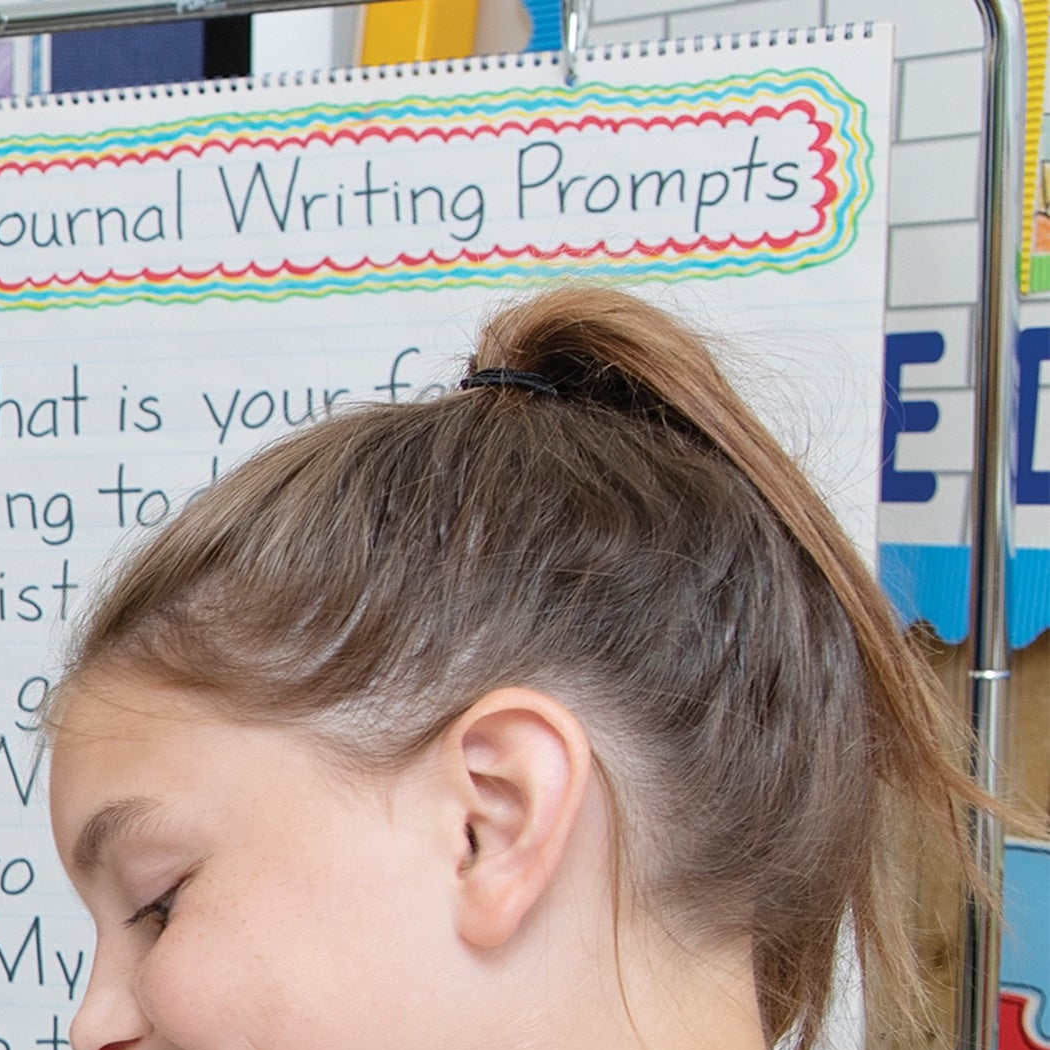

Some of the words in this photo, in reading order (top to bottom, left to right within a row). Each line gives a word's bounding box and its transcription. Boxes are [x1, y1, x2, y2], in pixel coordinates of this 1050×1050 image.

[218, 160, 486, 241] Writing
[517, 136, 801, 232] Prompts
[118, 386, 163, 432] is
[203, 387, 350, 444] your
[98, 462, 170, 528] to
